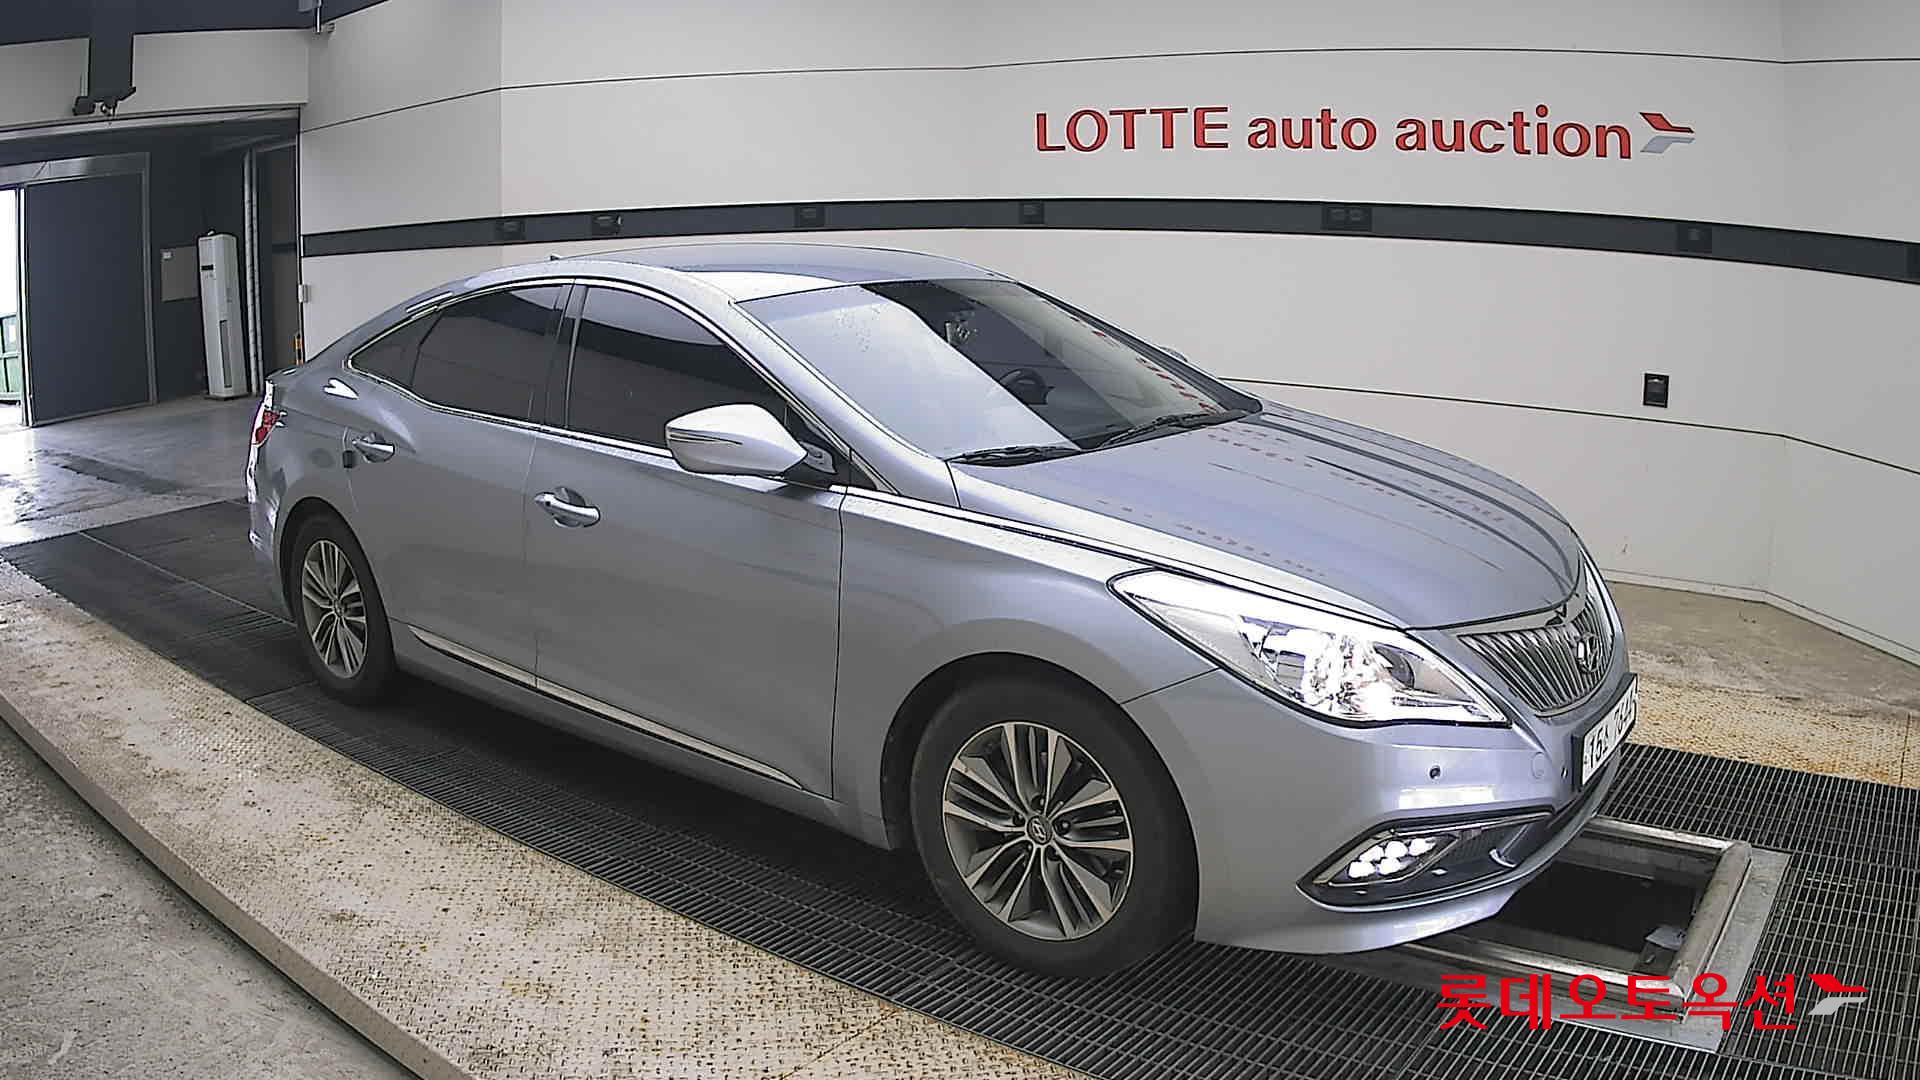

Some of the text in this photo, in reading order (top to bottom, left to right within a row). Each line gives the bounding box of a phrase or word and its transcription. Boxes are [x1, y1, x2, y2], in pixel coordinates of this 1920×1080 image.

[1035, 104, 1632, 159] LOTTE auto auction
